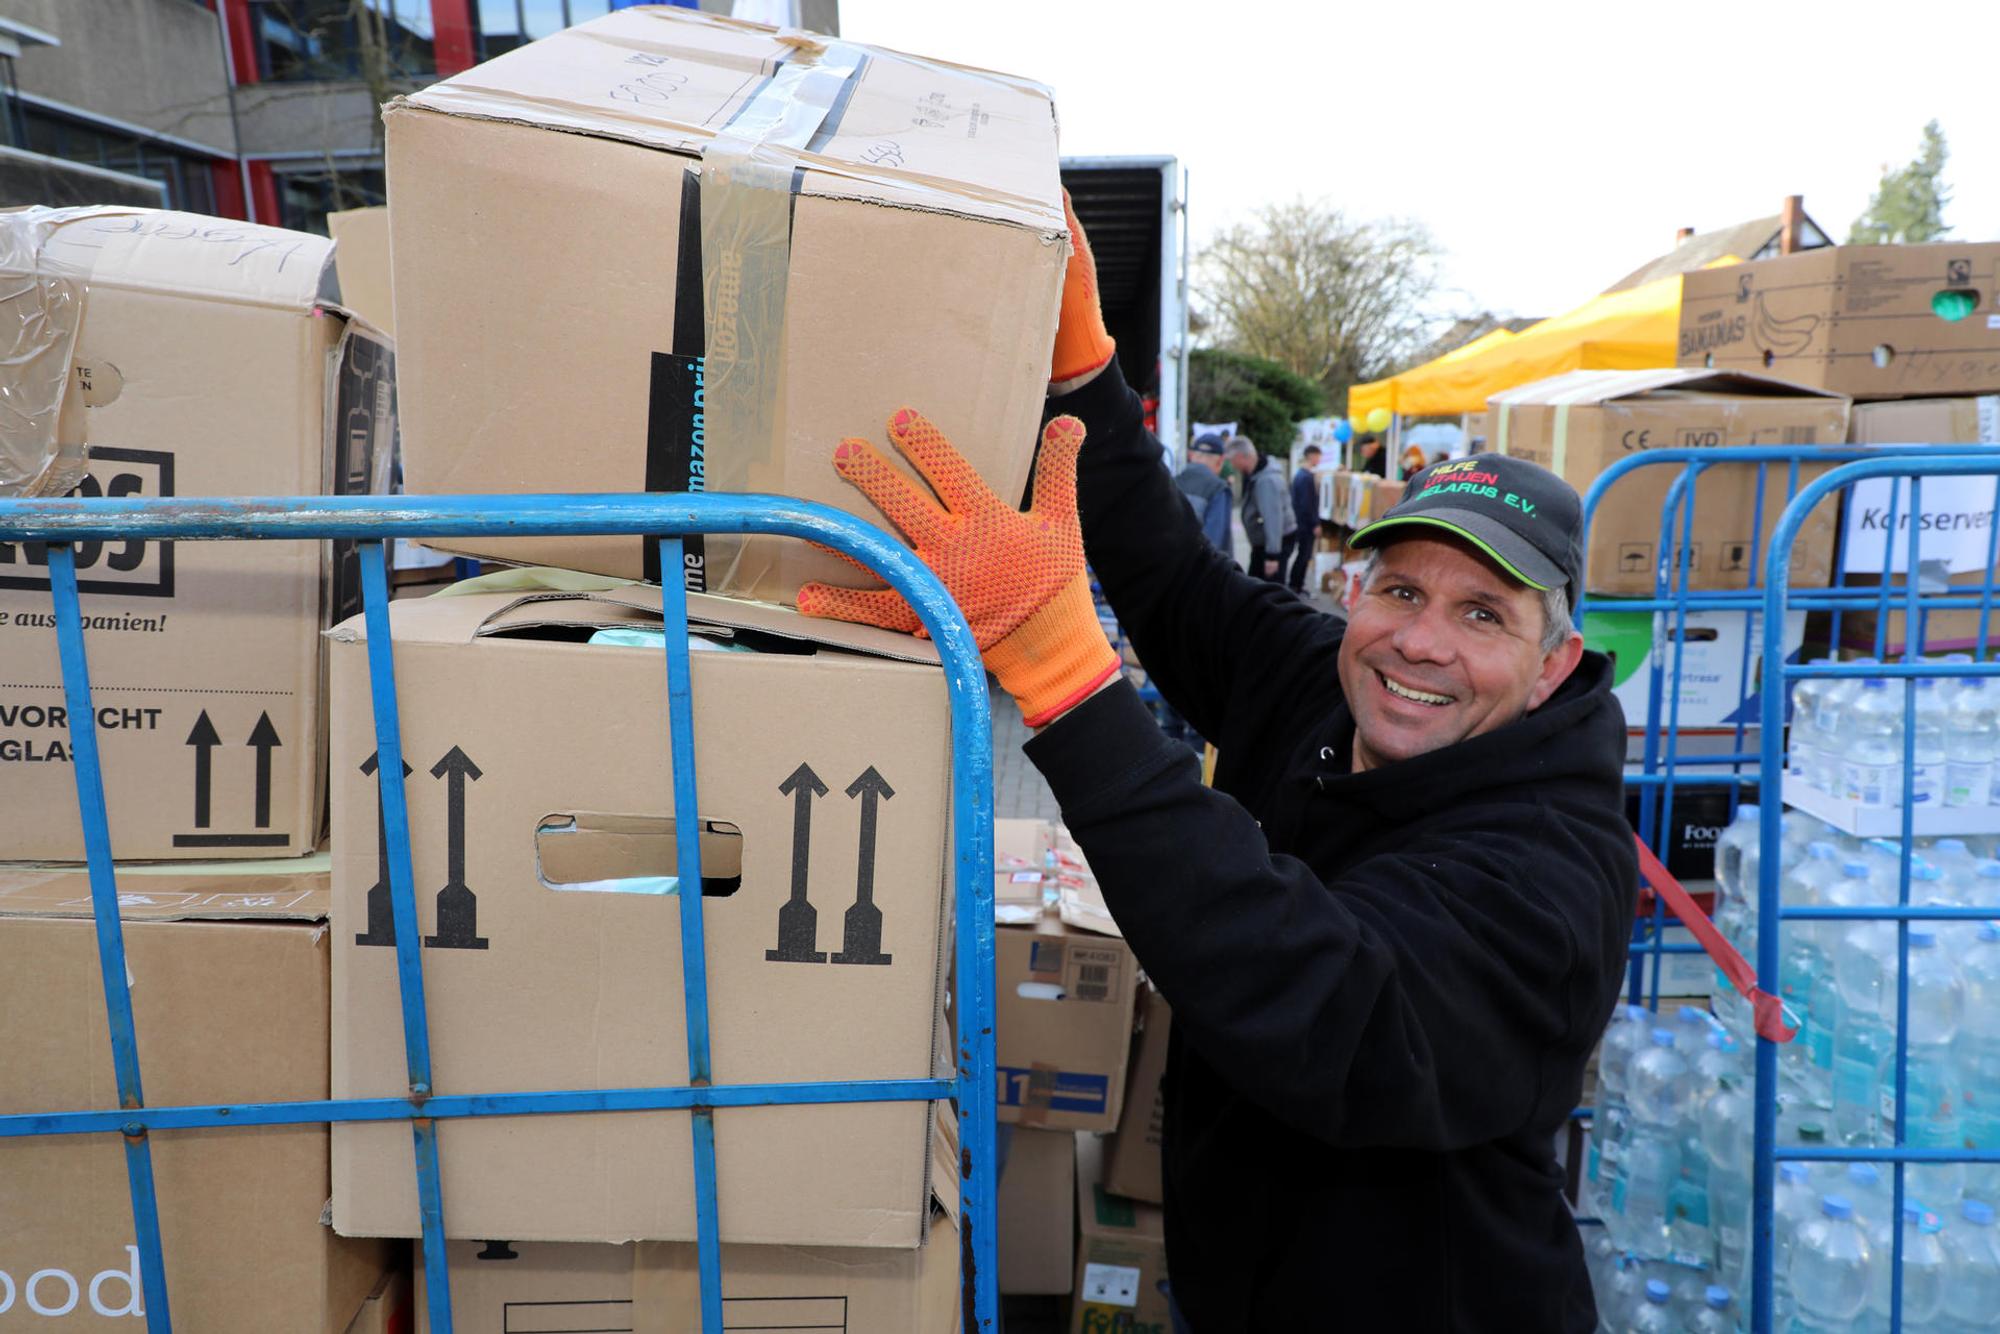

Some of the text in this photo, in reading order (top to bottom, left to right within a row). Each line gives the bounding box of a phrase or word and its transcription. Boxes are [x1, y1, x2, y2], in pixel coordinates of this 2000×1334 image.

[1681, 315, 1745, 356] BANANAS
[76, 367, 92, 378] TE
[80, 381, 92, 391] N
[687, 357, 705, 493] mazon pri
[1684, 431, 1719, 448] IVD
[1429, 460, 1479, 477] HILFE
[1503, 493, 1537, 519] E.V.
[15, 612, 57, 628] aus
[80, 612, 167, 632] panien!
[0, 705, 162, 730] VORCHT
[0, 739, 75, 762] GLA
[1684, 824, 1723, 841] Foo
